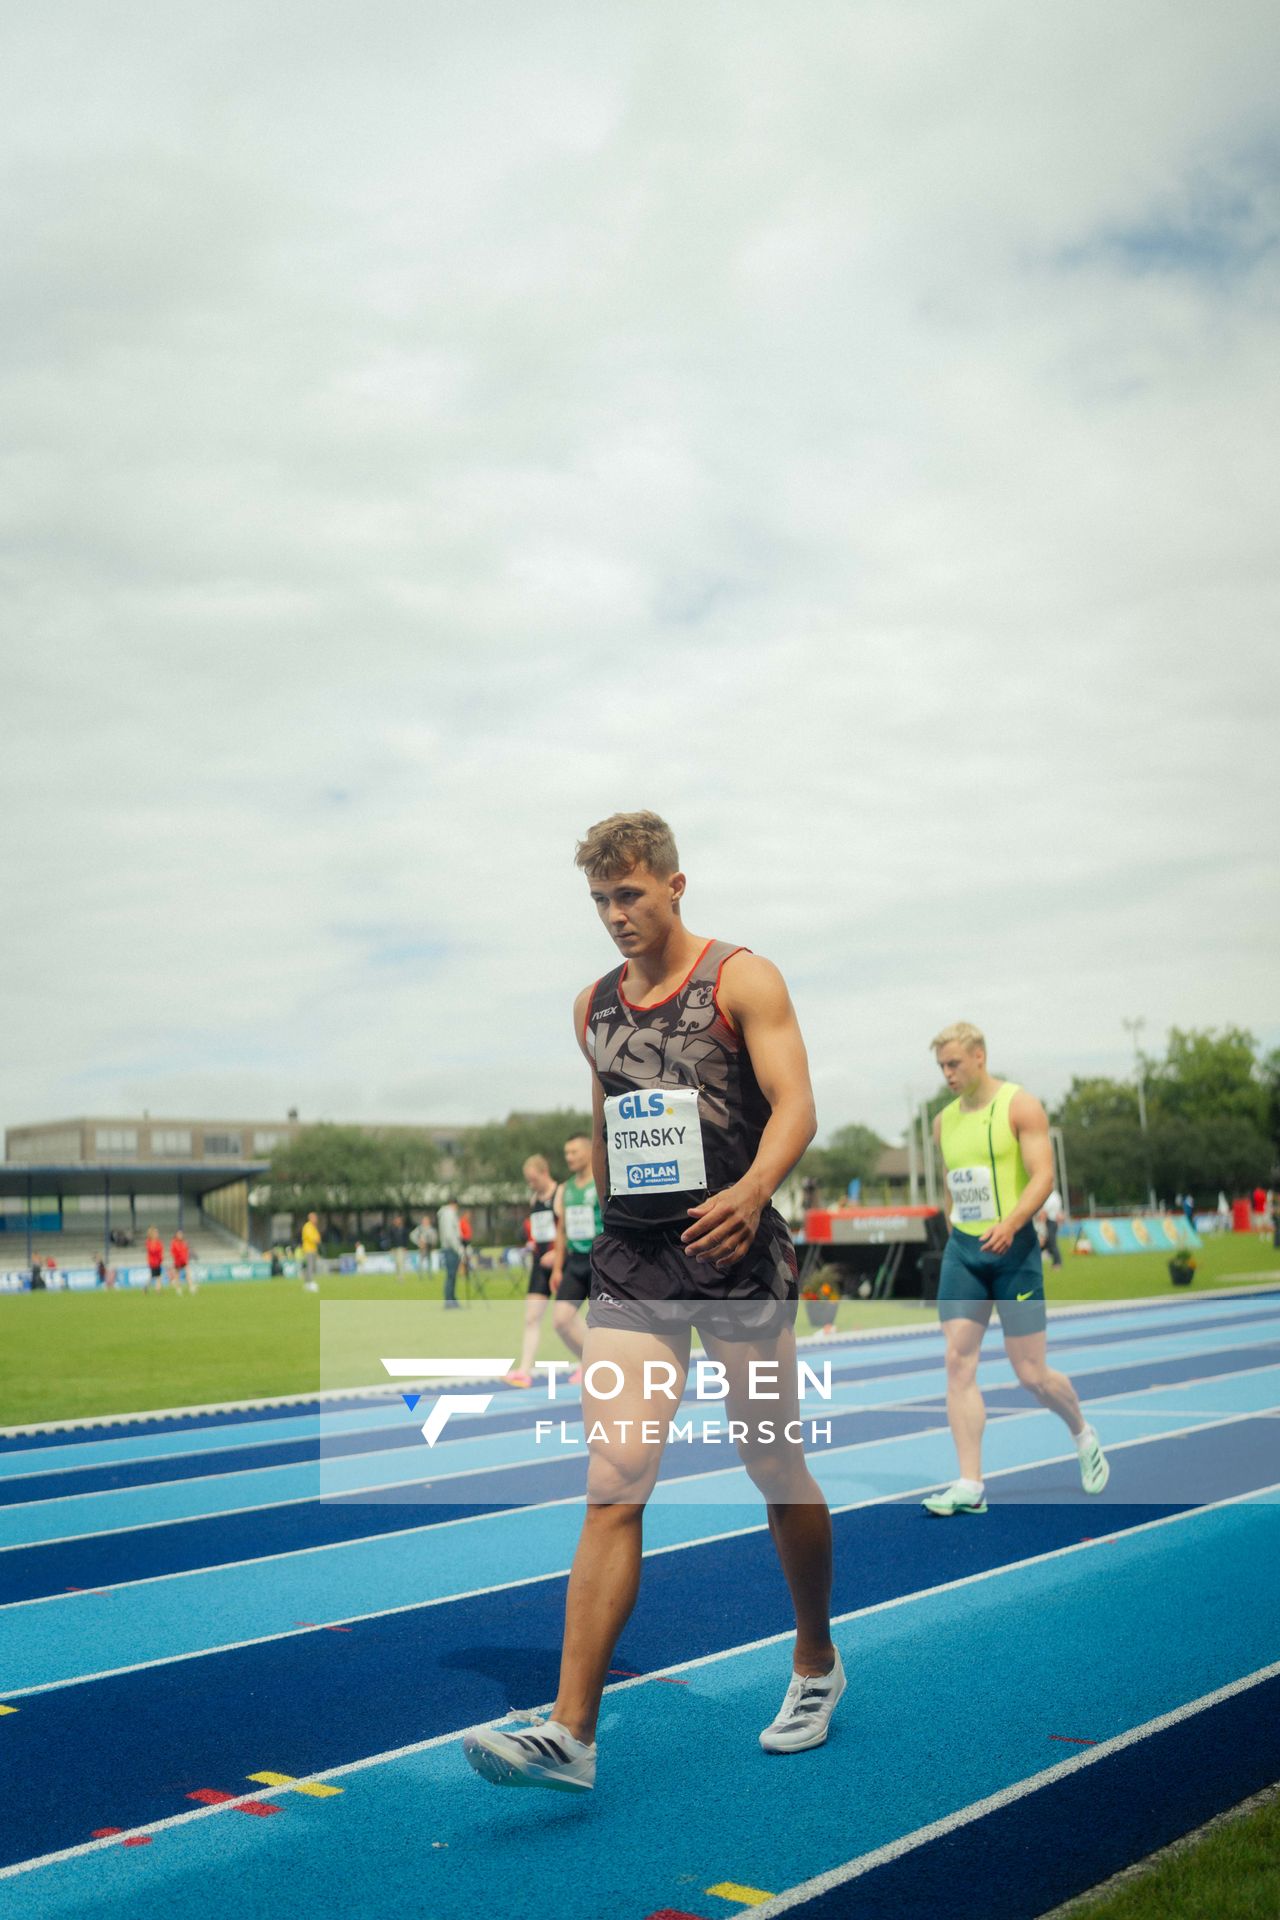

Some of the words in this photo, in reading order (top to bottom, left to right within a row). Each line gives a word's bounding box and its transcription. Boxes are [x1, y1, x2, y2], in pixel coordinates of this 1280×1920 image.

[595, 1022, 719, 1088] VSK
[618, 1093, 665, 1120] GLS
[614, 1126, 686, 1150] STRASKY
[644, 1165, 676, 1178] PLAN
[952, 1170, 973, 1184] GLS
